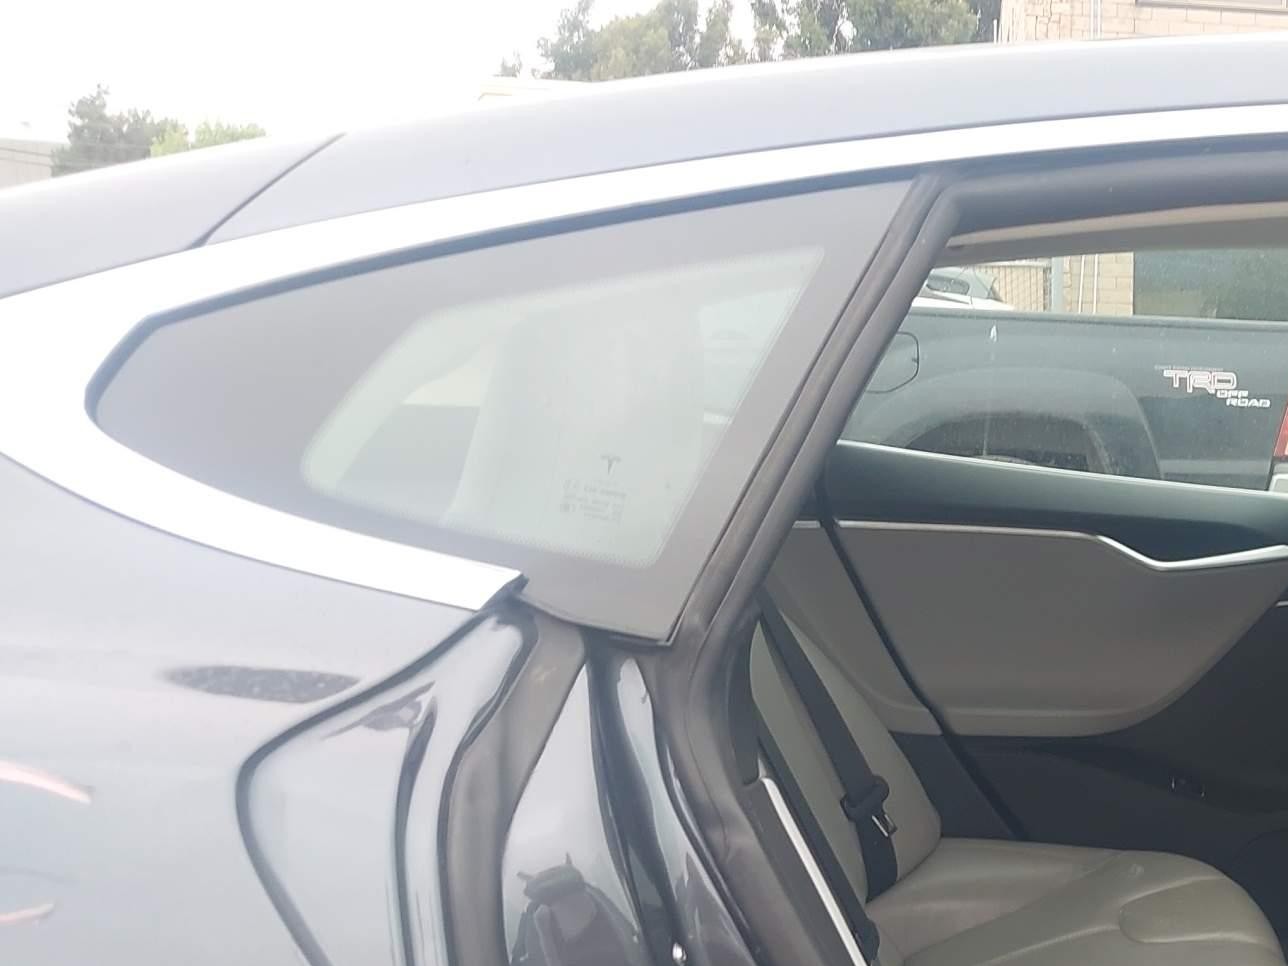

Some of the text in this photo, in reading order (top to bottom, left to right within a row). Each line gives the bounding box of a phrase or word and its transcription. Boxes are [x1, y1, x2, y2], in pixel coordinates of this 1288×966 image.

[1163, 369, 1237, 394] TRD
[1216, 390, 1249, 398] OFF
[1226, 398, 1271, 408] ROAD
